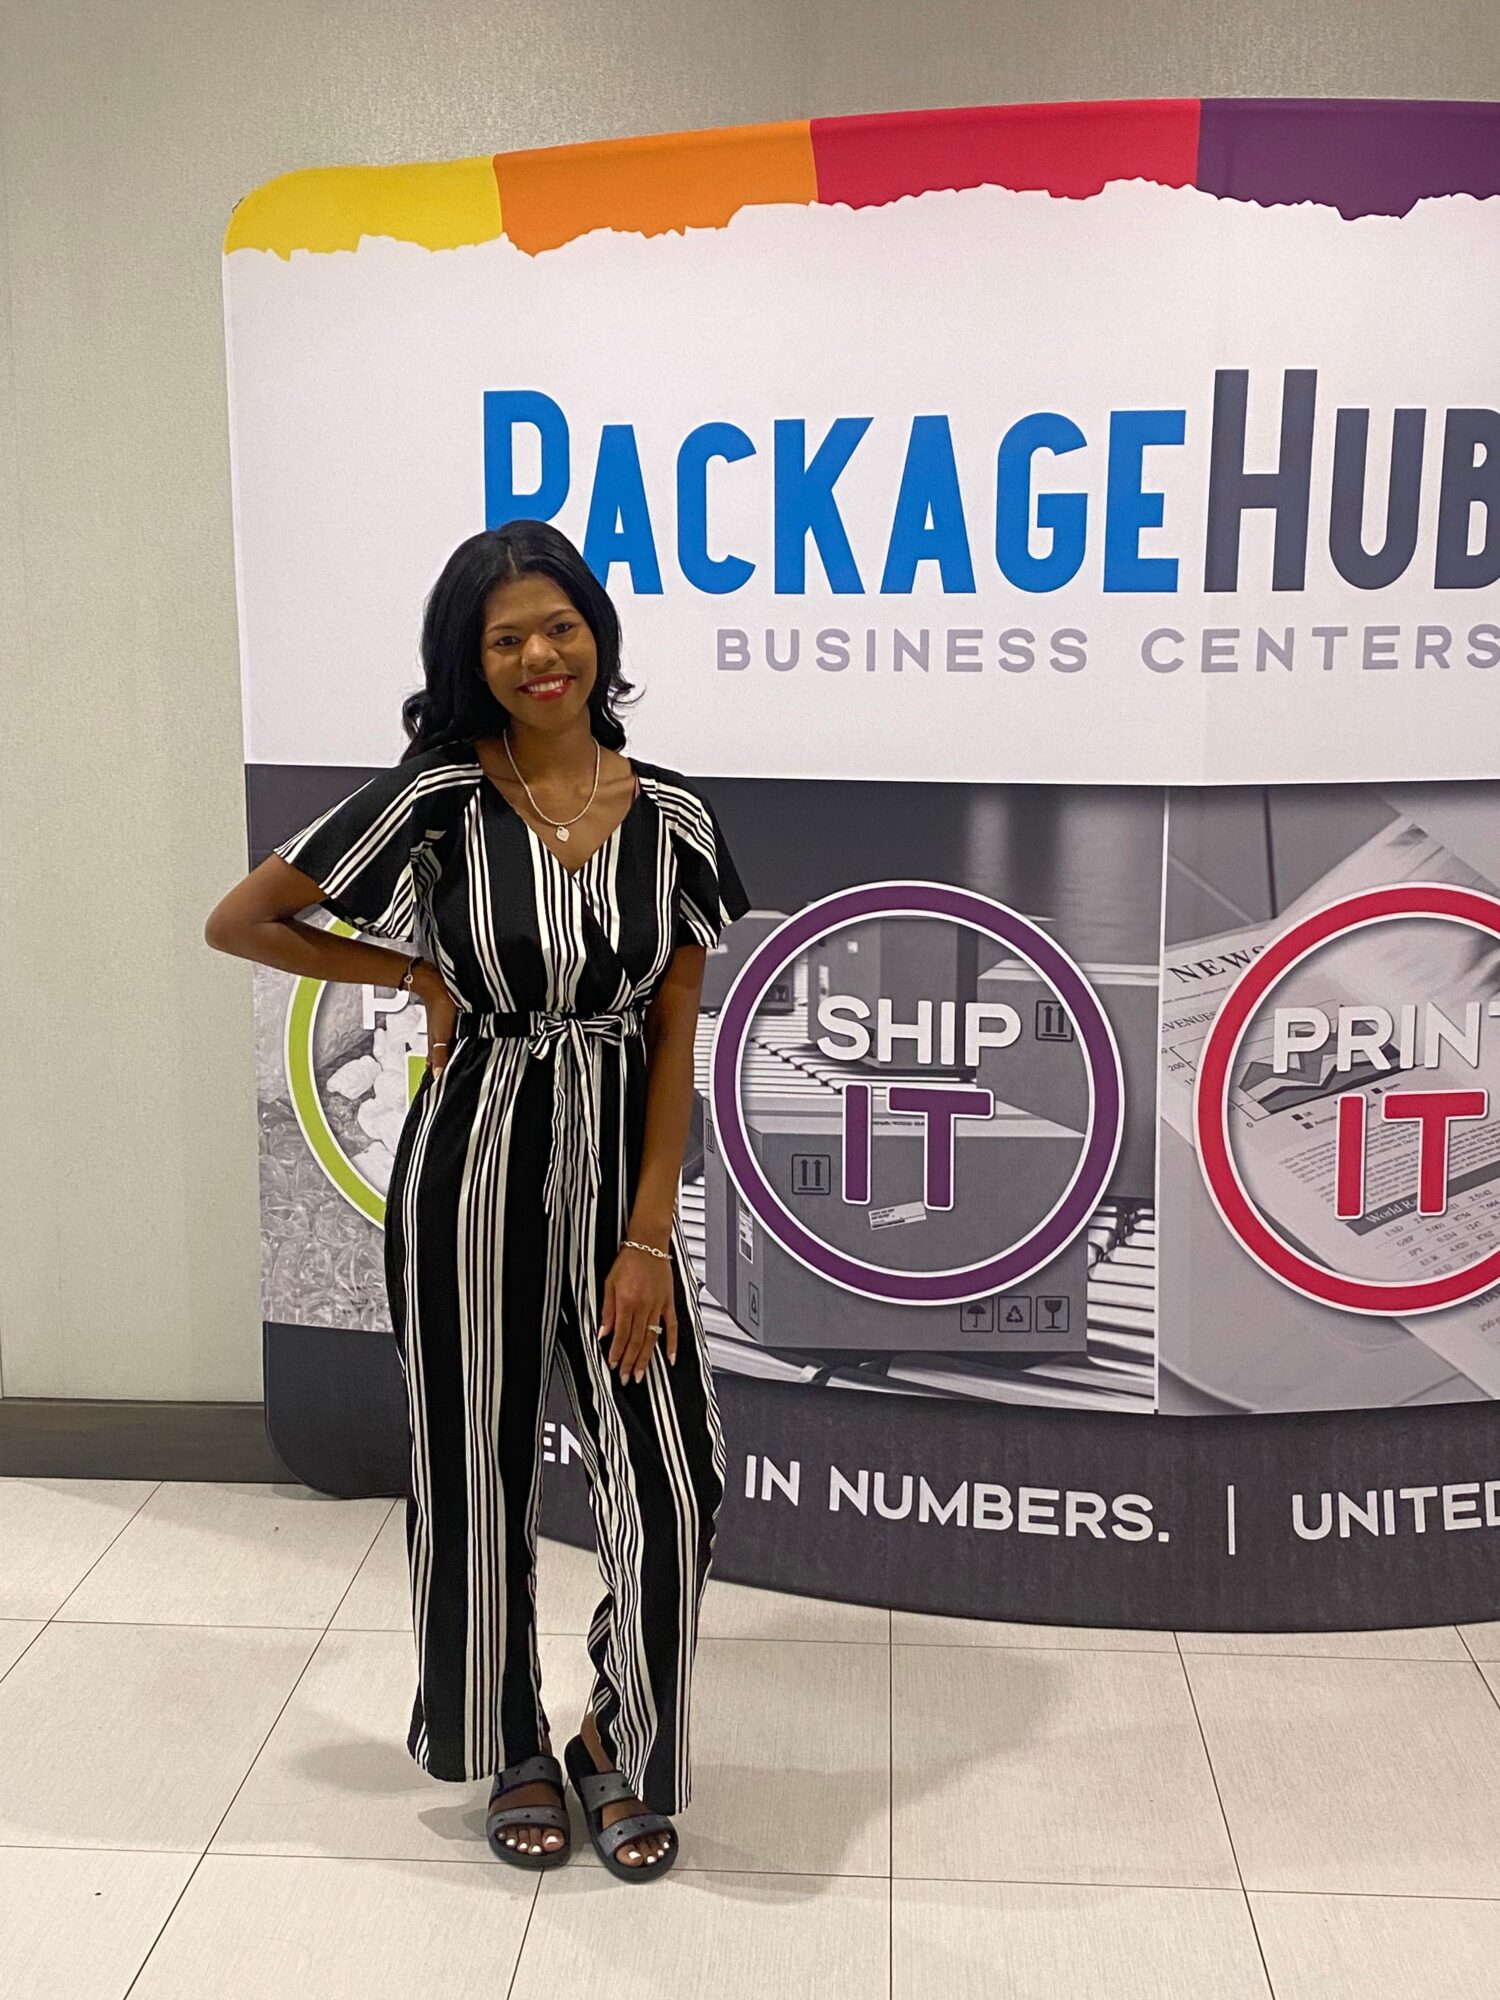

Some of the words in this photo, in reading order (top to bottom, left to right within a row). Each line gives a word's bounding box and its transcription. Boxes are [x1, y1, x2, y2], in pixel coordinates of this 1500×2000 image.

[717, 628, 1088, 673] BUSINESS
[1141, 624, 1500, 673] CENTERS
[816, 995, 1022, 1067] SHIP
[1273, 1001, 1500, 1074] PRIN
[842, 1081, 995, 1211] IT
[1334, 1088, 1488, 1220] IT
[1365, 1202, 1403, 1223] World
[745, 1454, 801, 1507] IN
[829, 1465, 1170, 1542] NUMBERS.
